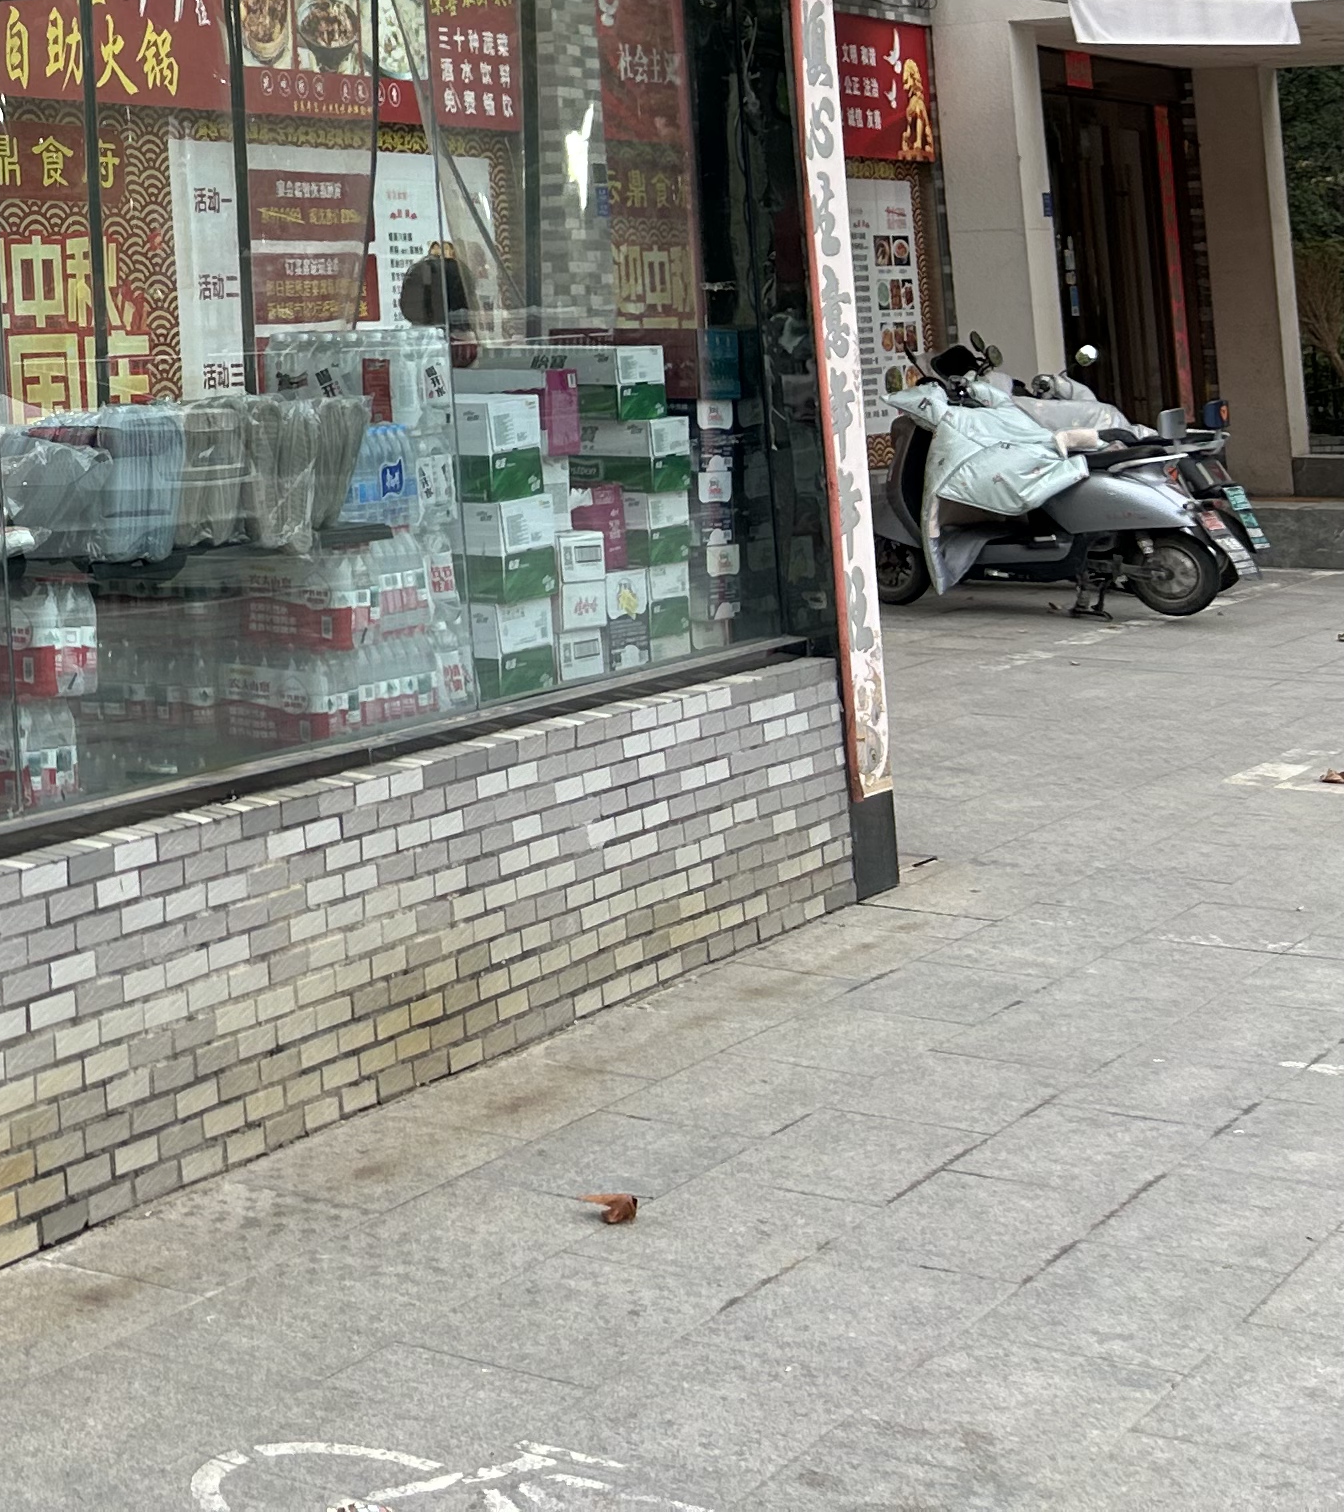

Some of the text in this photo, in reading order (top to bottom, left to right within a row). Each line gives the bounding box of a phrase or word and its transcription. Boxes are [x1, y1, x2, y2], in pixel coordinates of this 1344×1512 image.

[5, 5, 180, 97] 自助火锅
[841, 41, 858, 65] 文明
[193, 186, 233, 214] 活动一
[199, 273, 240, 301] 活动二
[202, 361, 245, 390] 活动三
